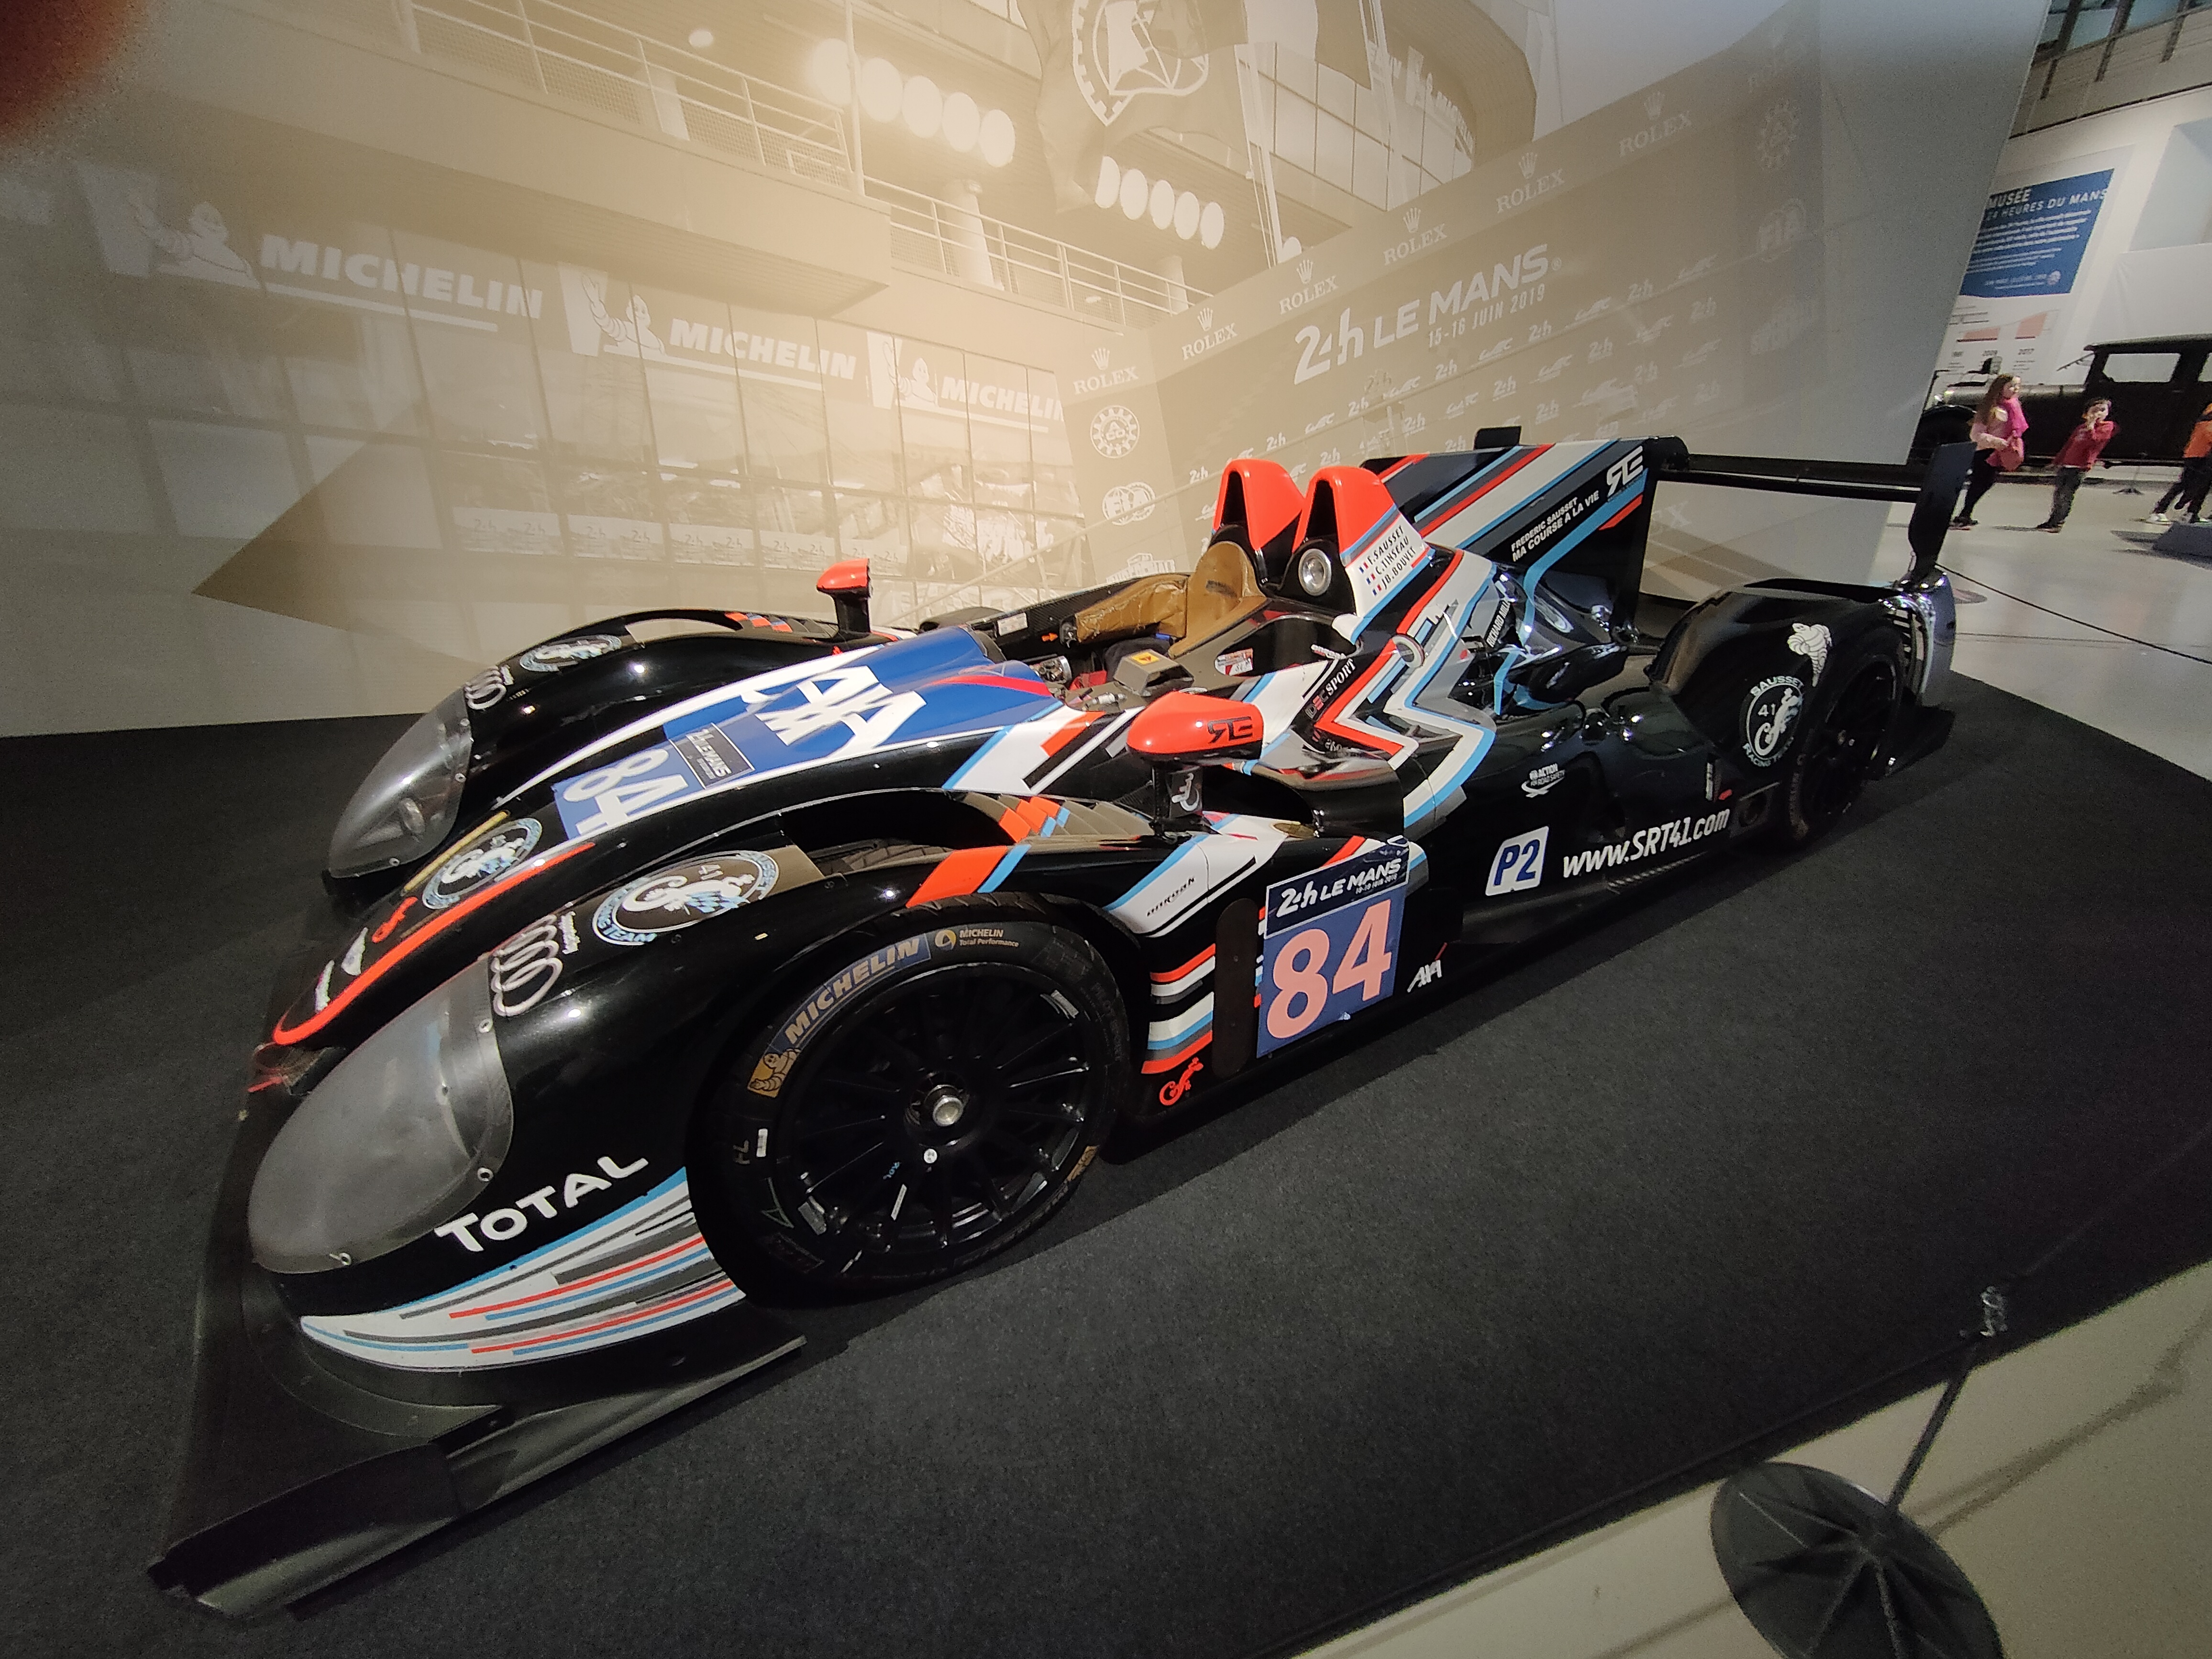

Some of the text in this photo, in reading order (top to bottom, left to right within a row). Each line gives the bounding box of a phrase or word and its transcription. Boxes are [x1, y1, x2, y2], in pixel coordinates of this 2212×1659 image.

[1618, 111, 1693, 157] ROLEX
[1495, 168, 1565, 213] ROLEX
[2002, 201, 2044, 218] HEURES
[2047, 197, 2067, 209] DU
[2069, 188, 2107, 205] MANS
[1383, 223, 1448, 266] ROLEX
[260, 234, 542, 319] MICHELIN
[1279, 276, 1339, 314] ROLEX
[1373, 300, 1420, 349] LE
[1428, 283, 1545, 348] 15-16 JUIN 2019
[670, 318, 857, 379] MICHELIN
[1182, 323, 1238, 361] ROLEX
[1073, 366, 1139, 395] ROLEX
[1511, 497, 1578, 552] FREDERIC SAUSSET
[1512, 490, 1600, 562] MA COURSE A LA VIE
[1375, 535, 1410, 575] C.TINSEAU
[1486, 615, 1504, 648] RICHARD
[1326, 658, 1356, 696] SPORT
[1750, 675, 1804, 696] SAUSSET
[1758, 703, 1776, 717] 41
[1538, 763, 1558, 777] ACTION
[563, 748, 688, 837] 84
[1320, 880, 1346, 901] LE
[1347, 858, 1402, 891] MANS
[1493, 839, 1540, 886] P2
[959, 929, 1004, 938] MICHELIN
[977, 938, 1019, 948] Performance
[785, 938, 921, 1044] MICHELIN
[1267, 899, 1392, 1040] 84
[434, 1155, 648, 1252] TOTAL
